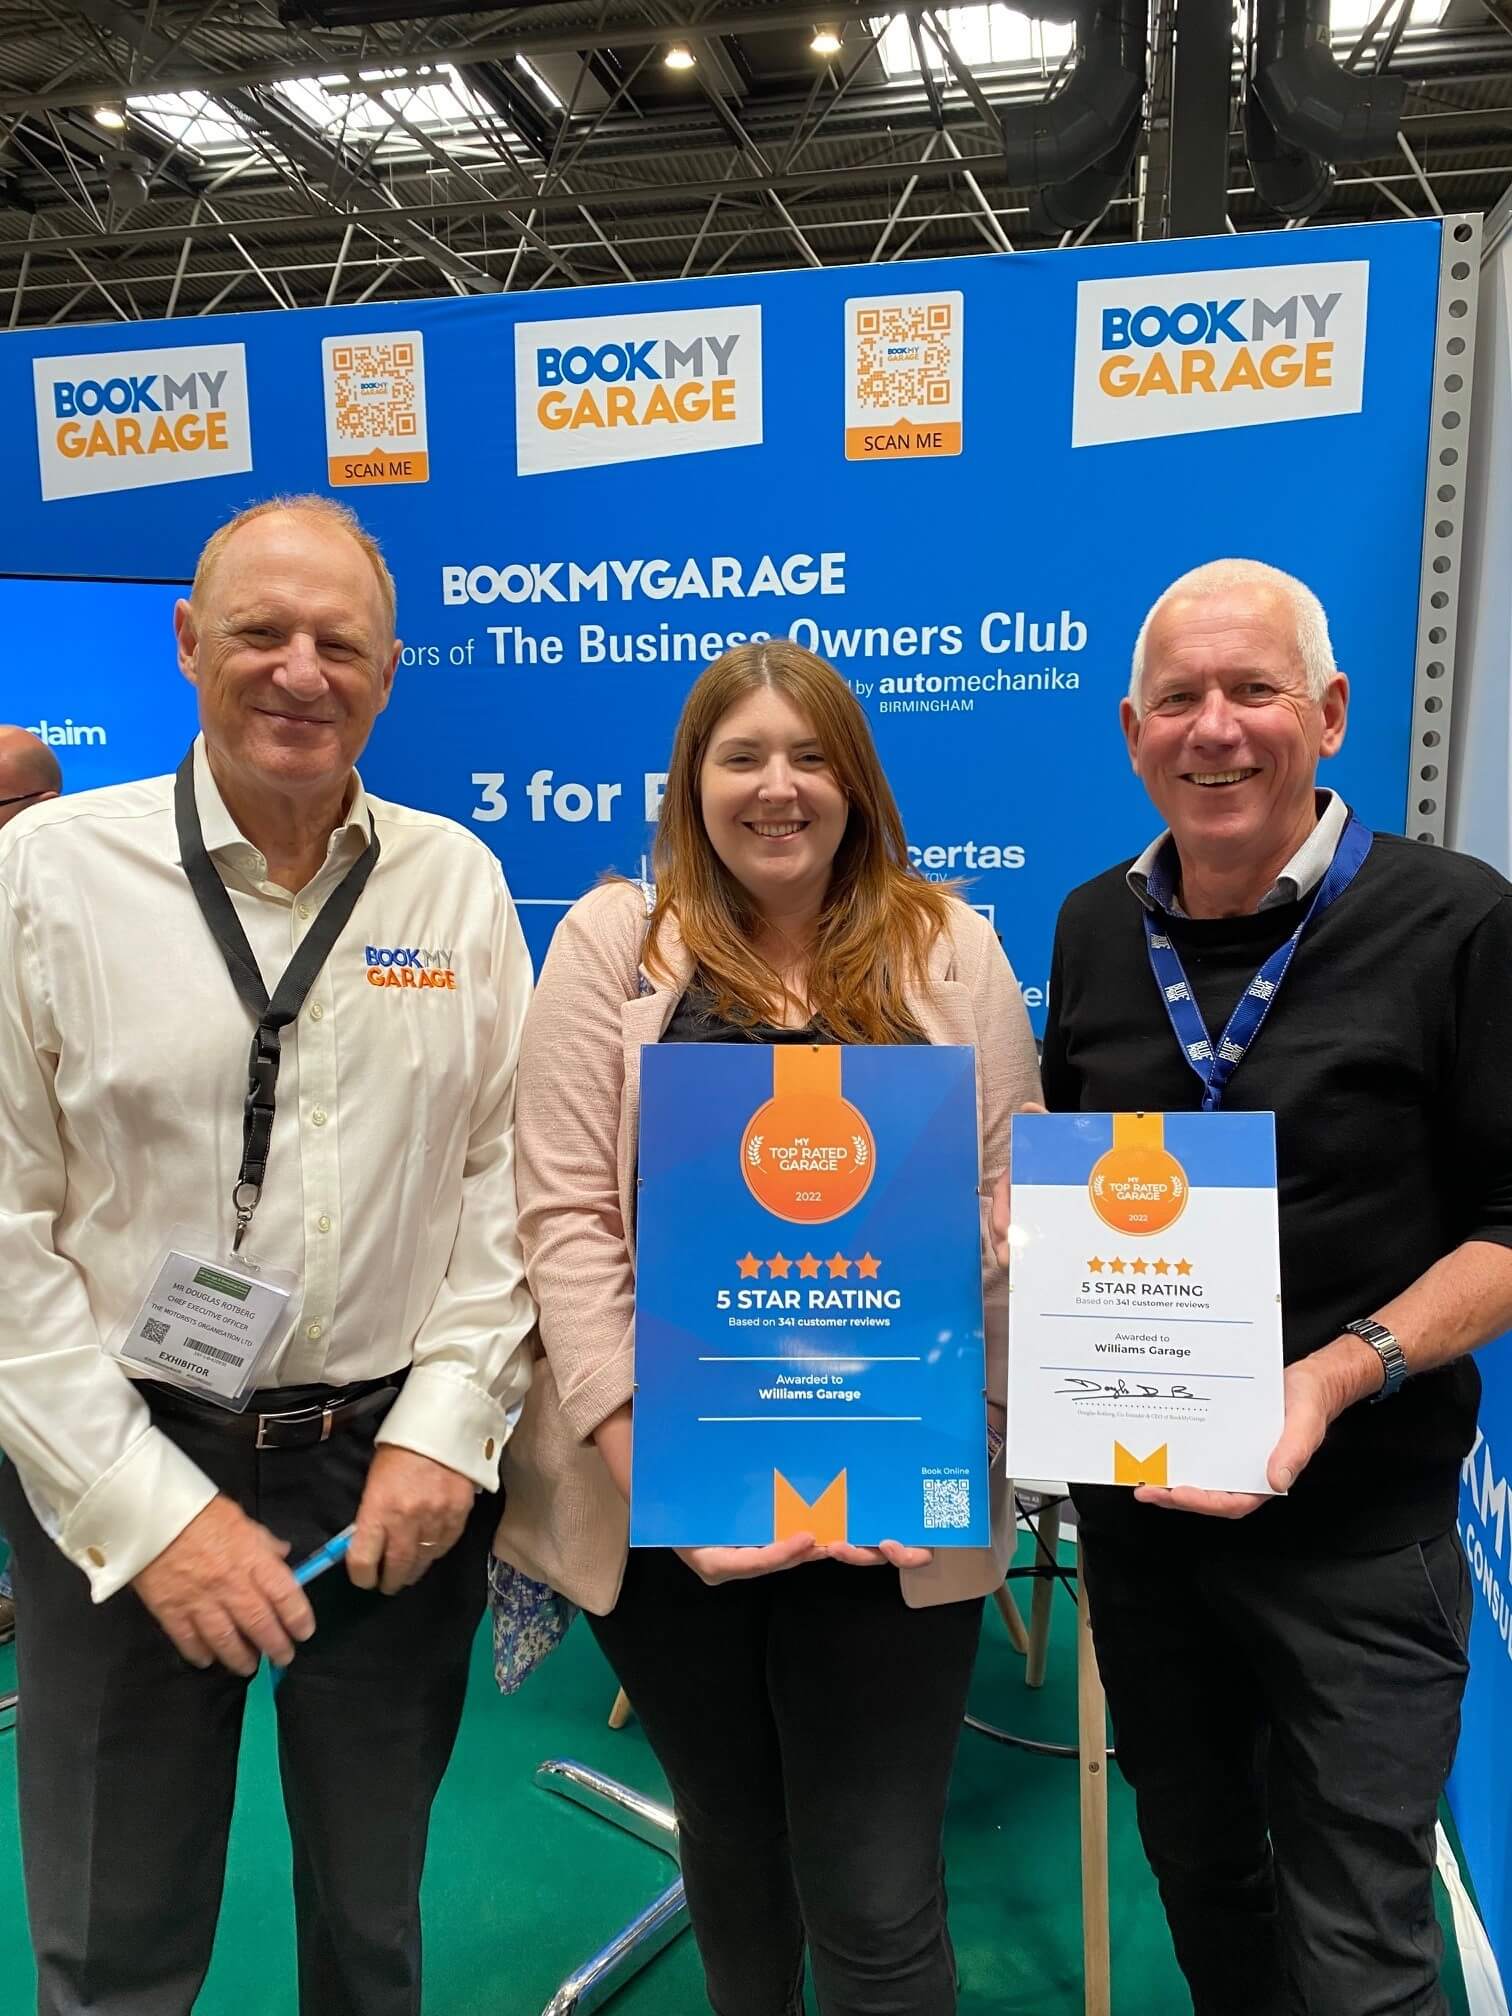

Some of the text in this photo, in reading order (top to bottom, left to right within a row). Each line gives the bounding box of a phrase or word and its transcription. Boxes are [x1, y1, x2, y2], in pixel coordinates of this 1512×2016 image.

[1099, 341, 1334, 398] GARAGE
[537, 379, 736, 430] GARAGE
[56, 412, 229, 459] GARAGE
[864, 432, 943, 451] SCAN ME
[345, 461, 412, 478] SCAN ME
[442, 552, 846, 605] BOOKMYGARAGE
[398, 647, 440, 666] ors
[449, 638, 475, 665] of
[487, 626, 563, 665] The
[788, 618, 963, 658] Owners
[980, 610, 1088, 654] Club
[856, 680, 873, 698] by
[879, 667, 1080, 694] automechanika
[879, 699, 974, 713] BIRMINGHAM
[471, 773, 508, 822] 3
[526, 769, 622, 822] for
[907, 840, 1026, 869] certas
[367, 967, 457, 990] GARAGE
[794, 1137, 810, 1146] MY
[769, 1147, 848, 1159] TOP RATED
[779, 1159, 839, 1171] GARAGE
[795, 1191, 822, 1201] 2022
[1109, 1183, 1168, 1193] TOP RATED
[1116, 1191, 1161, 1201] GARAGE
[1128, 1214, 1148, 1222] 2022
[1081, 1281, 1204, 1297] 5 STAR RATING
[172, 1283, 184, 1292] MR
[186, 1287, 220, 1306] DOUGLAS
[222, 1301, 256, 1320] ROTBERG
[716, 1290, 901, 1309] 5 STAR RATING
[1075, 1297, 1101, 1305] Based
[1116, 1298, 1130, 1306] 341
[1132, 1299, 1173, 1308] customer
[1176, 1301, 1210, 1309] reviews
[168, 1295, 249, 1331] CHIEF EXECUTIVE OFFICER
[151, 1303, 163, 1313] THE
[164, 1308, 197, 1325] MOTORISTS
[197, 1322, 240, 1342] ORGANISATION
[728, 1317, 891, 1327] Based on 341 customer reviews
[1115, 1333, 1158, 1342] Awarded
[1094, 1343, 1191, 1358] Williams Garage
[158, 1351, 210, 1377] EXHIBITOR
[776, 1374, 843, 1385] Awarded to
[759, 1388, 861, 1402] Williams Garage
[921, 1466, 970, 1475] Book Online
